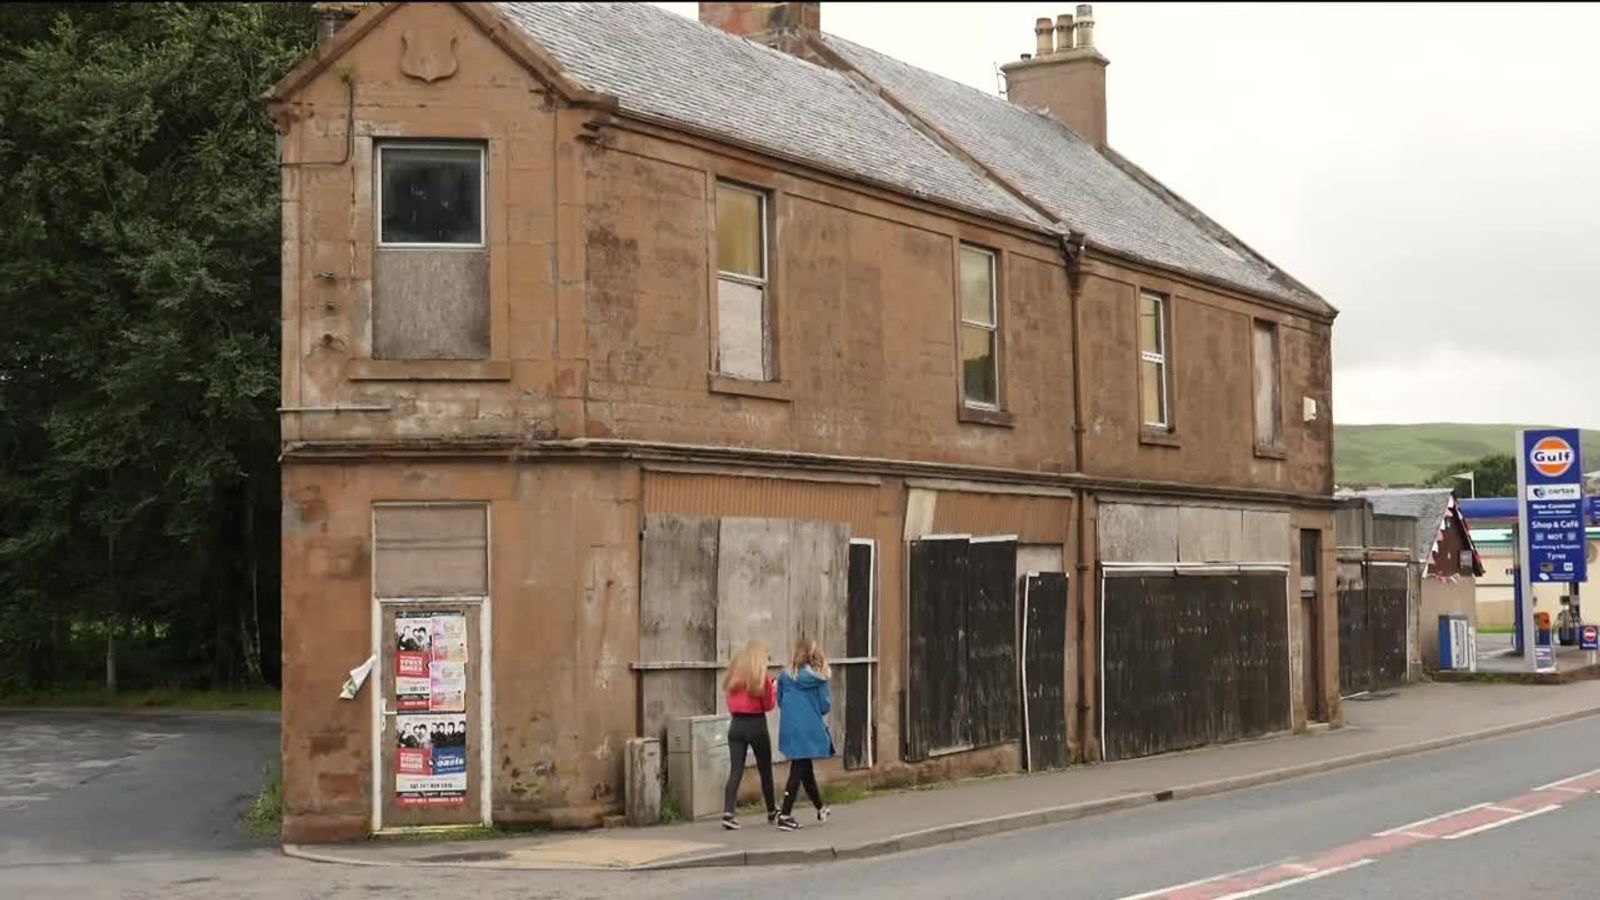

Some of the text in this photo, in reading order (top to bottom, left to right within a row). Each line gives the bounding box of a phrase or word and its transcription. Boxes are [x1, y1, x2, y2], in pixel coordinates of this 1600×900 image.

[1534, 451, 1570, 462] Gulf
[1531, 521, 1553, 530] Shop
[1560, 520, 1579, 528] Café
